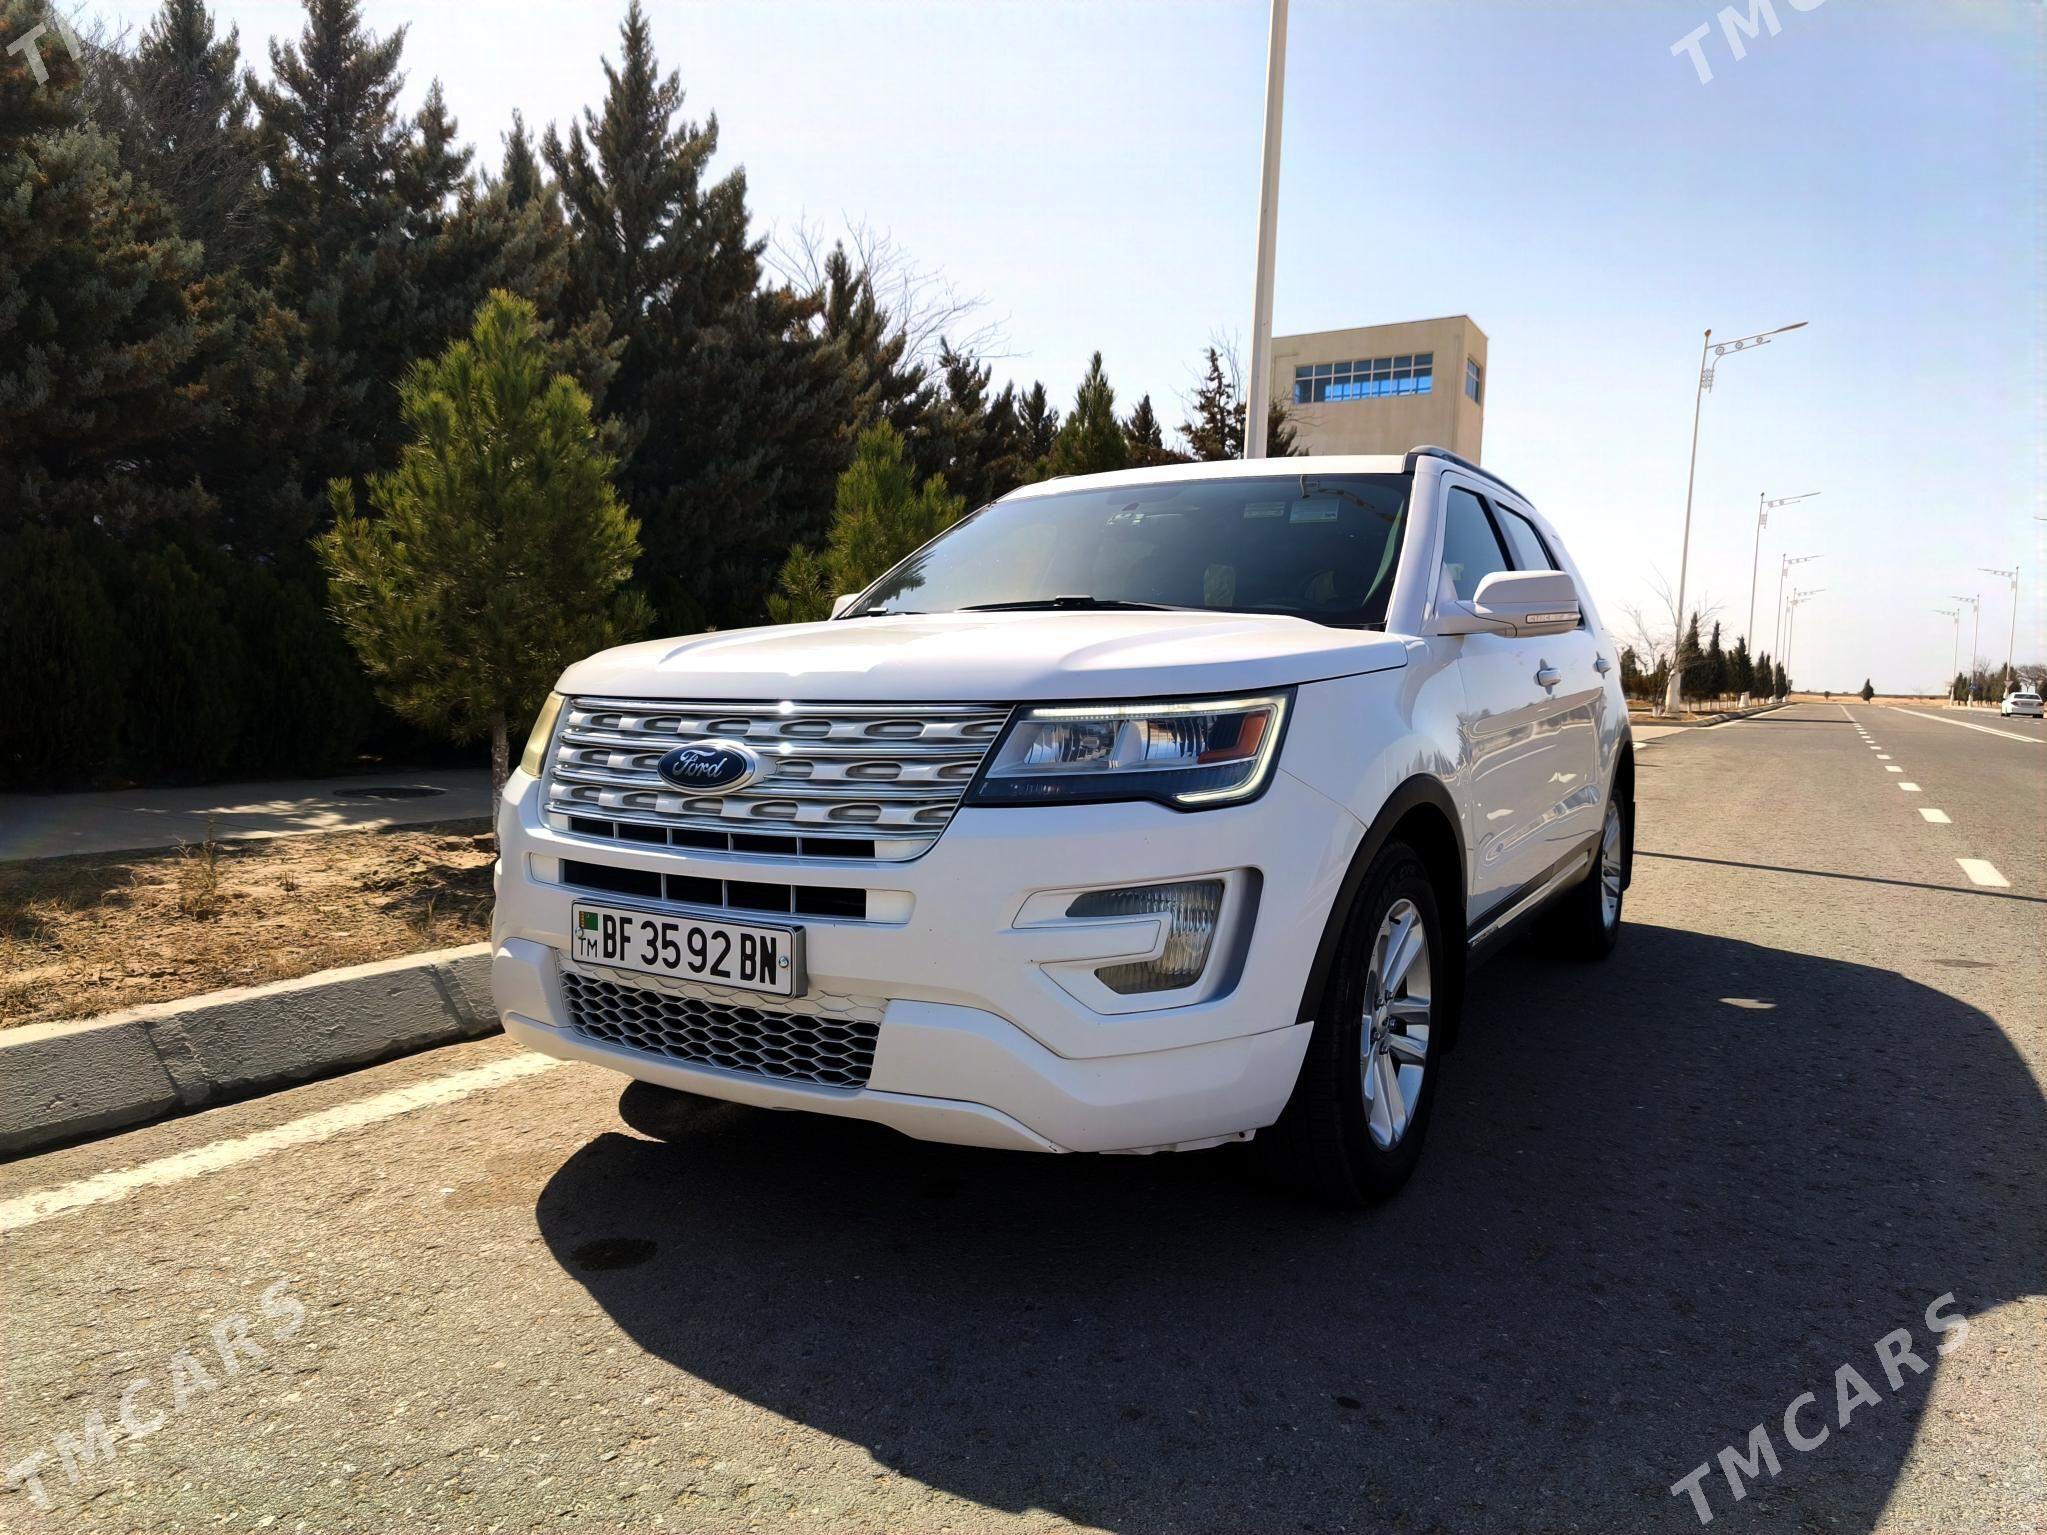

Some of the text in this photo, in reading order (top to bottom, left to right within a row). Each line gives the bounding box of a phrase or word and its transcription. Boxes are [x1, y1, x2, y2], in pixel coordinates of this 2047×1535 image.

[672, 749, 728, 778] Ford
[578, 937, 598, 958] TM
[603, 914, 777, 986] BF 3592 BN
